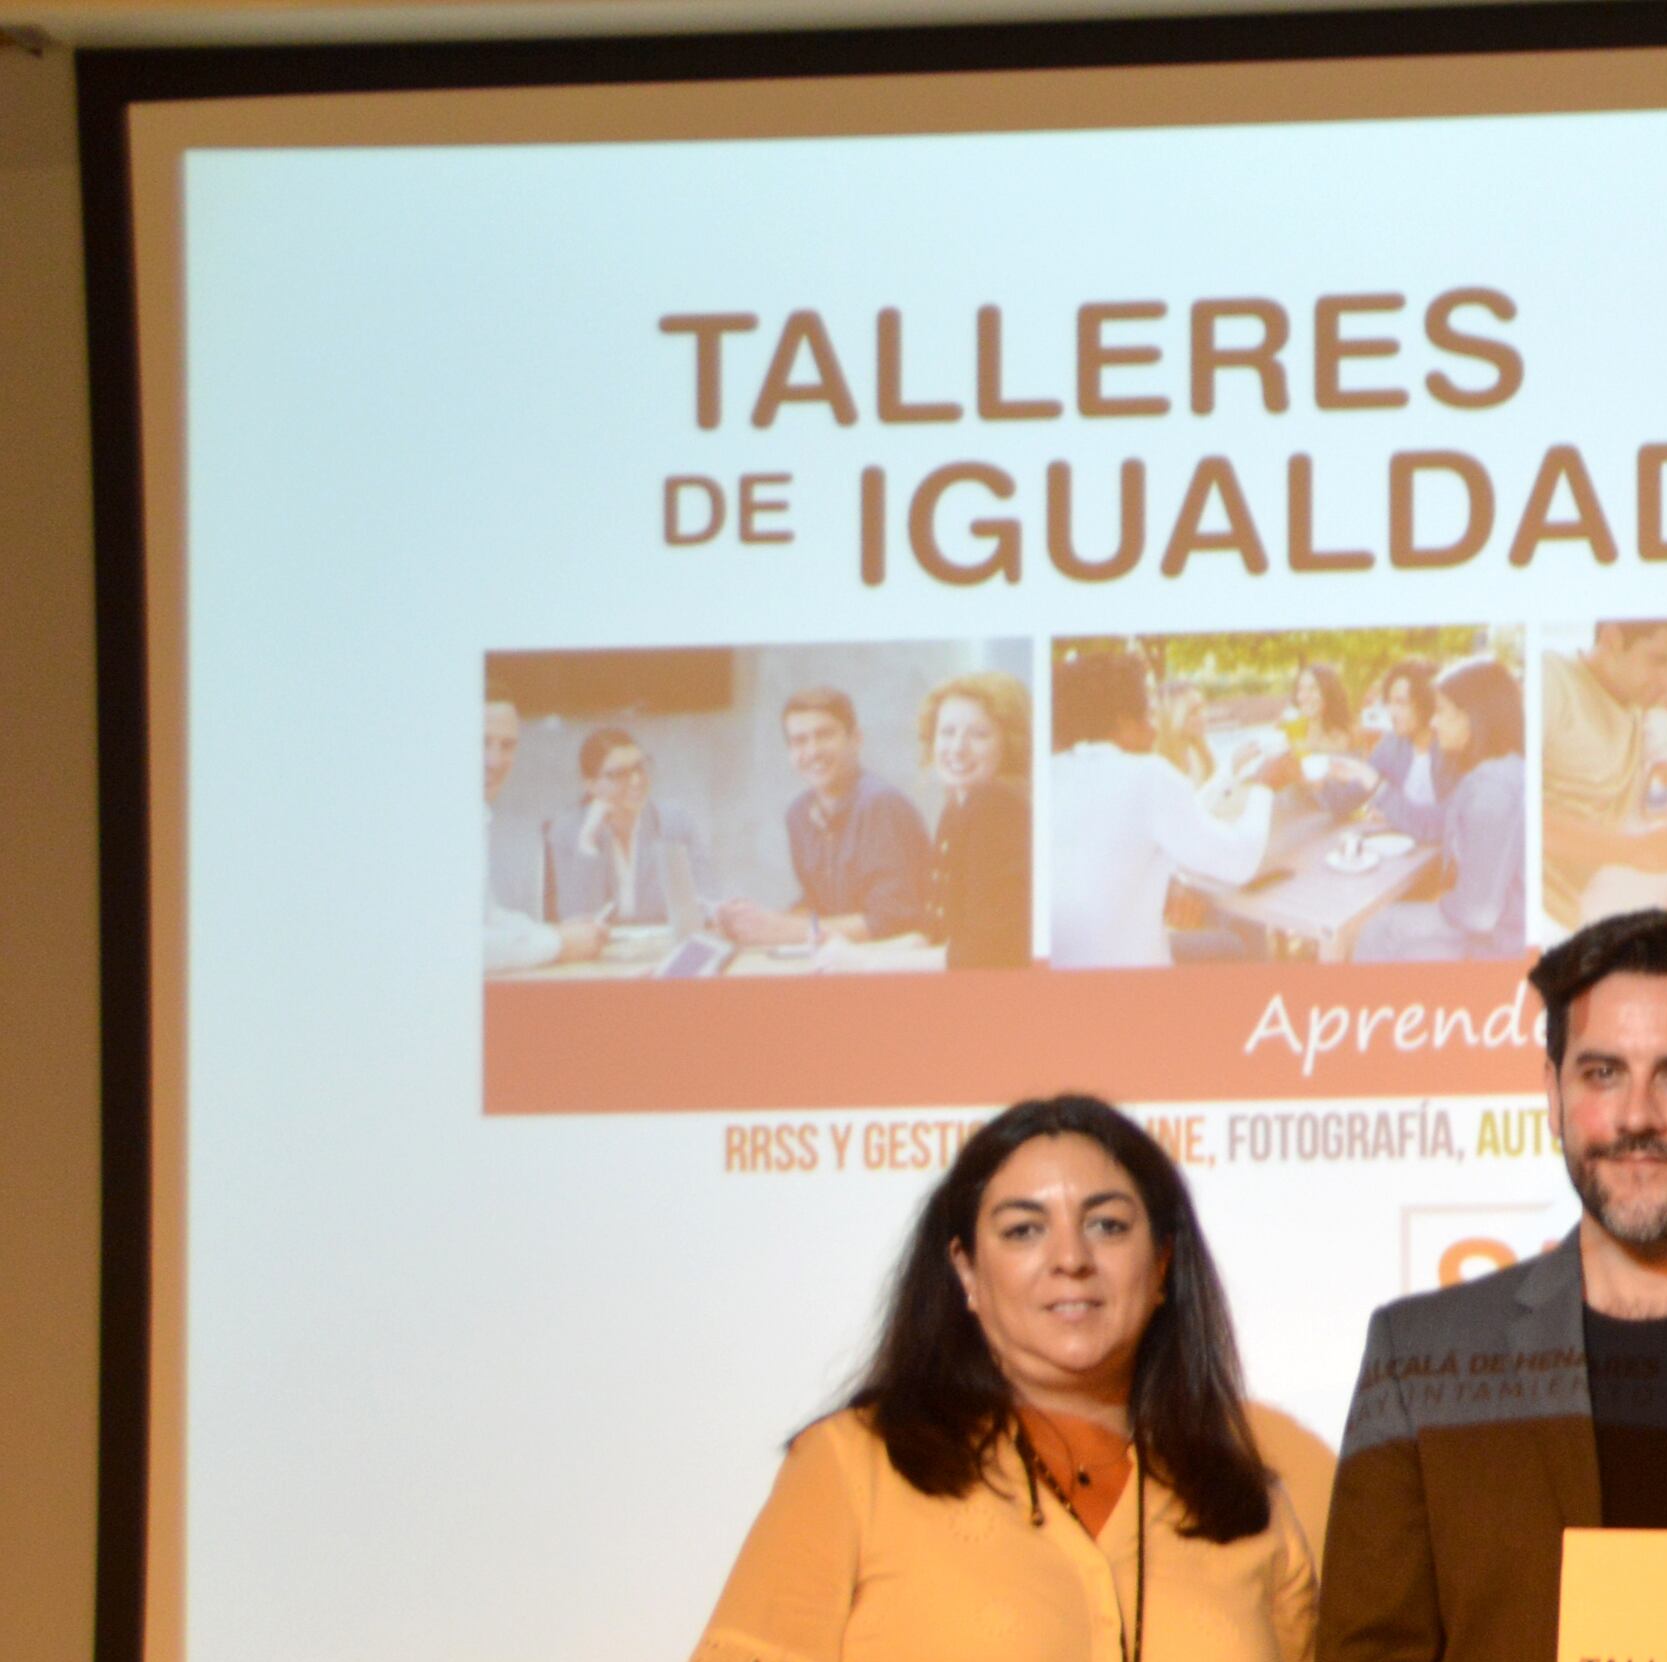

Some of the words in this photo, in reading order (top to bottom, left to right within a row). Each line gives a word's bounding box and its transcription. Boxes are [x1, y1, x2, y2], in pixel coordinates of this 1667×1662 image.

[659, 285, 1526, 432] TALLERES
[662, 471, 797, 548] DE
[724, 1121, 819, 1173] RRSS
[831, 1121, 854, 1171] Y
[1227, 1099, 1465, 1164] FOTOGRAFÍA,
[1476, 1107, 1563, 1158] AUT
